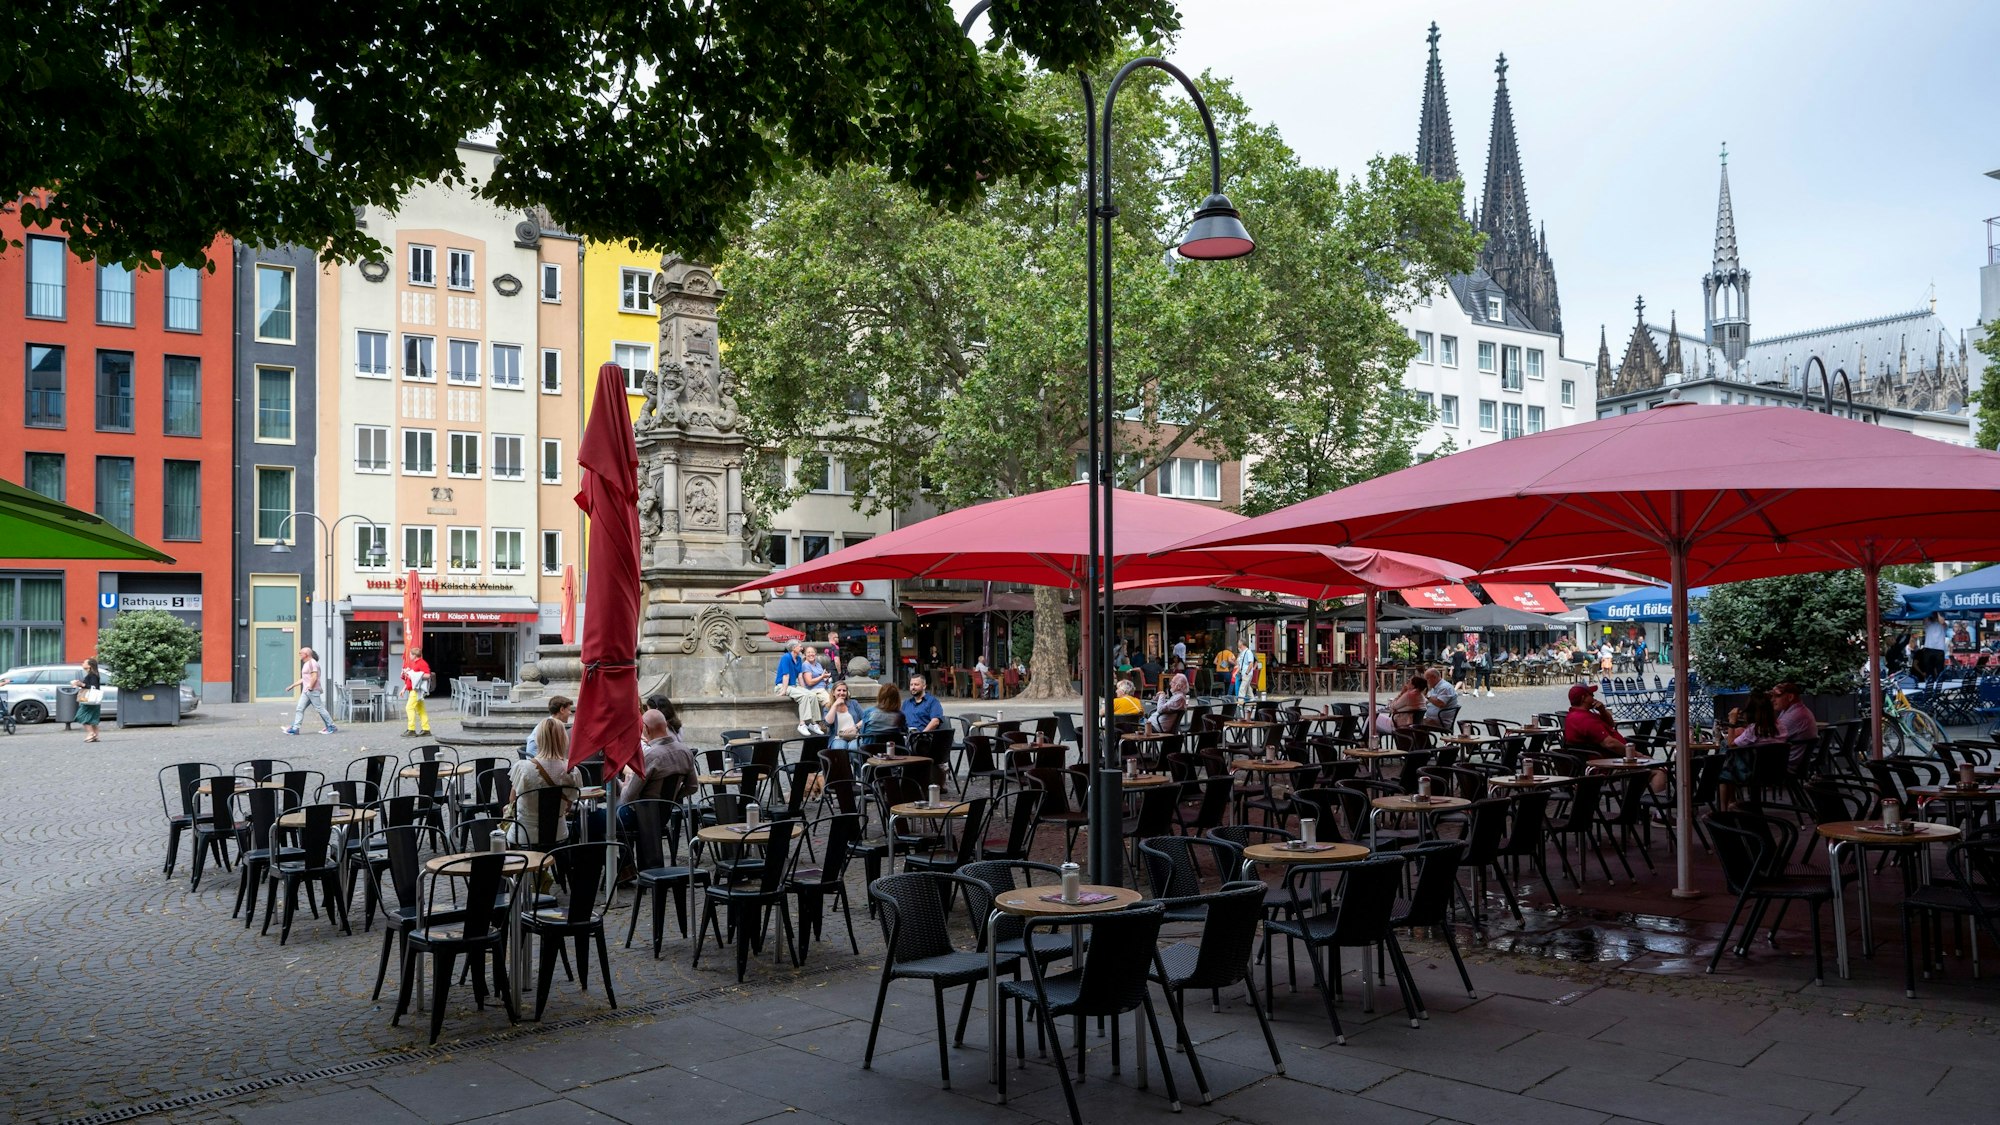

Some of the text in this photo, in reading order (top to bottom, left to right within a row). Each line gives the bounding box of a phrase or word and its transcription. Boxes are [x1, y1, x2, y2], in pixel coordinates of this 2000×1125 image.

[366, 579, 390, 590] von
[441, 582, 468, 590] Kölsch
[101, 593, 115, 608] U
[122, 597, 182, 607] Rathaus 5
[1955, 592, 1991, 606] Gaffel
[1607, 602, 1672, 618] Gaffel Kölsc
[422, 613, 440, 621] erth
